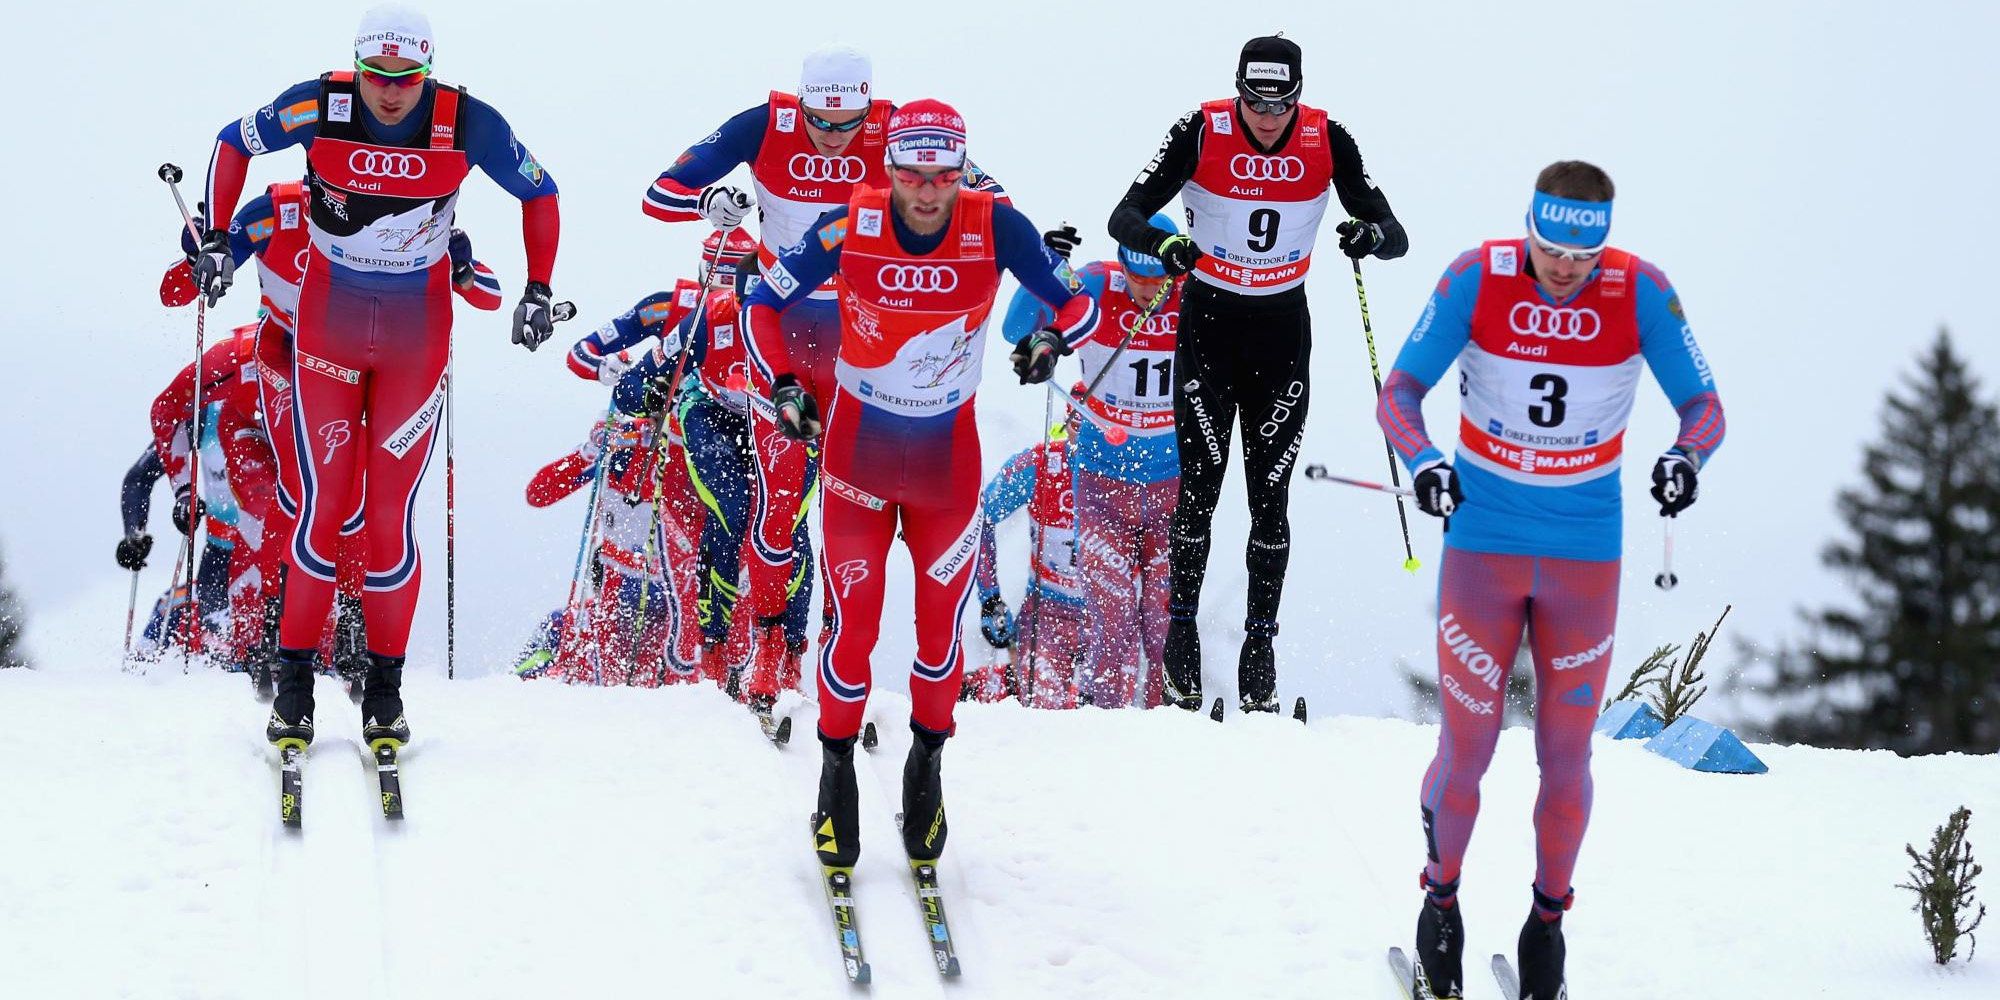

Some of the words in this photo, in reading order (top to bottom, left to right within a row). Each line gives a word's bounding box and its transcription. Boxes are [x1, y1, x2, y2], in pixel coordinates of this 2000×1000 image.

[1249, 67, 1278, 75] helvetia
[805, 84, 858, 94] SpareBank
[245, 114, 261, 151] BDO
[434, 125, 453, 133] 10TH
[900, 137, 946, 150] SpareBank
[1145, 131, 1173, 173] BKW
[347, 179, 382, 191] Audi
[787, 187, 823, 198] Audi
[1229, 185, 1263, 196] Audi
[1541, 202, 1607, 227] LUKOIL
[962, 233, 981, 242] 10TH
[1247, 208, 1281, 253] 9
[344, 253, 412, 267] OBERSTDORF
[1227, 252, 1288, 266] OBERSTDORF
[1214, 263, 1297, 286] VIESSMANN
[878, 296, 913, 307] Audi
[1506, 341, 1548, 357] Audi
[1681, 323, 1713, 388] LUKOIL
[304, 357, 348, 379] SPAR
[1128, 358, 1172, 397] 11
[874, 390, 944, 407] OBERSTDORF
[1528, 373, 1569, 428] 3
[1259, 380, 1304, 437] odlo
[389, 391, 444, 453] SpareBank
[1190, 396, 1222, 465] swisscom
[1504, 429, 1582, 446] OBERSTDORF
[1488, 441, 1597, 473] VIESSMANN
[823, 475, 870, 505] SPAR
[1252, 538, 1288, 550] swisscom
[1439, 613, 1504, 691] LUKOIL
